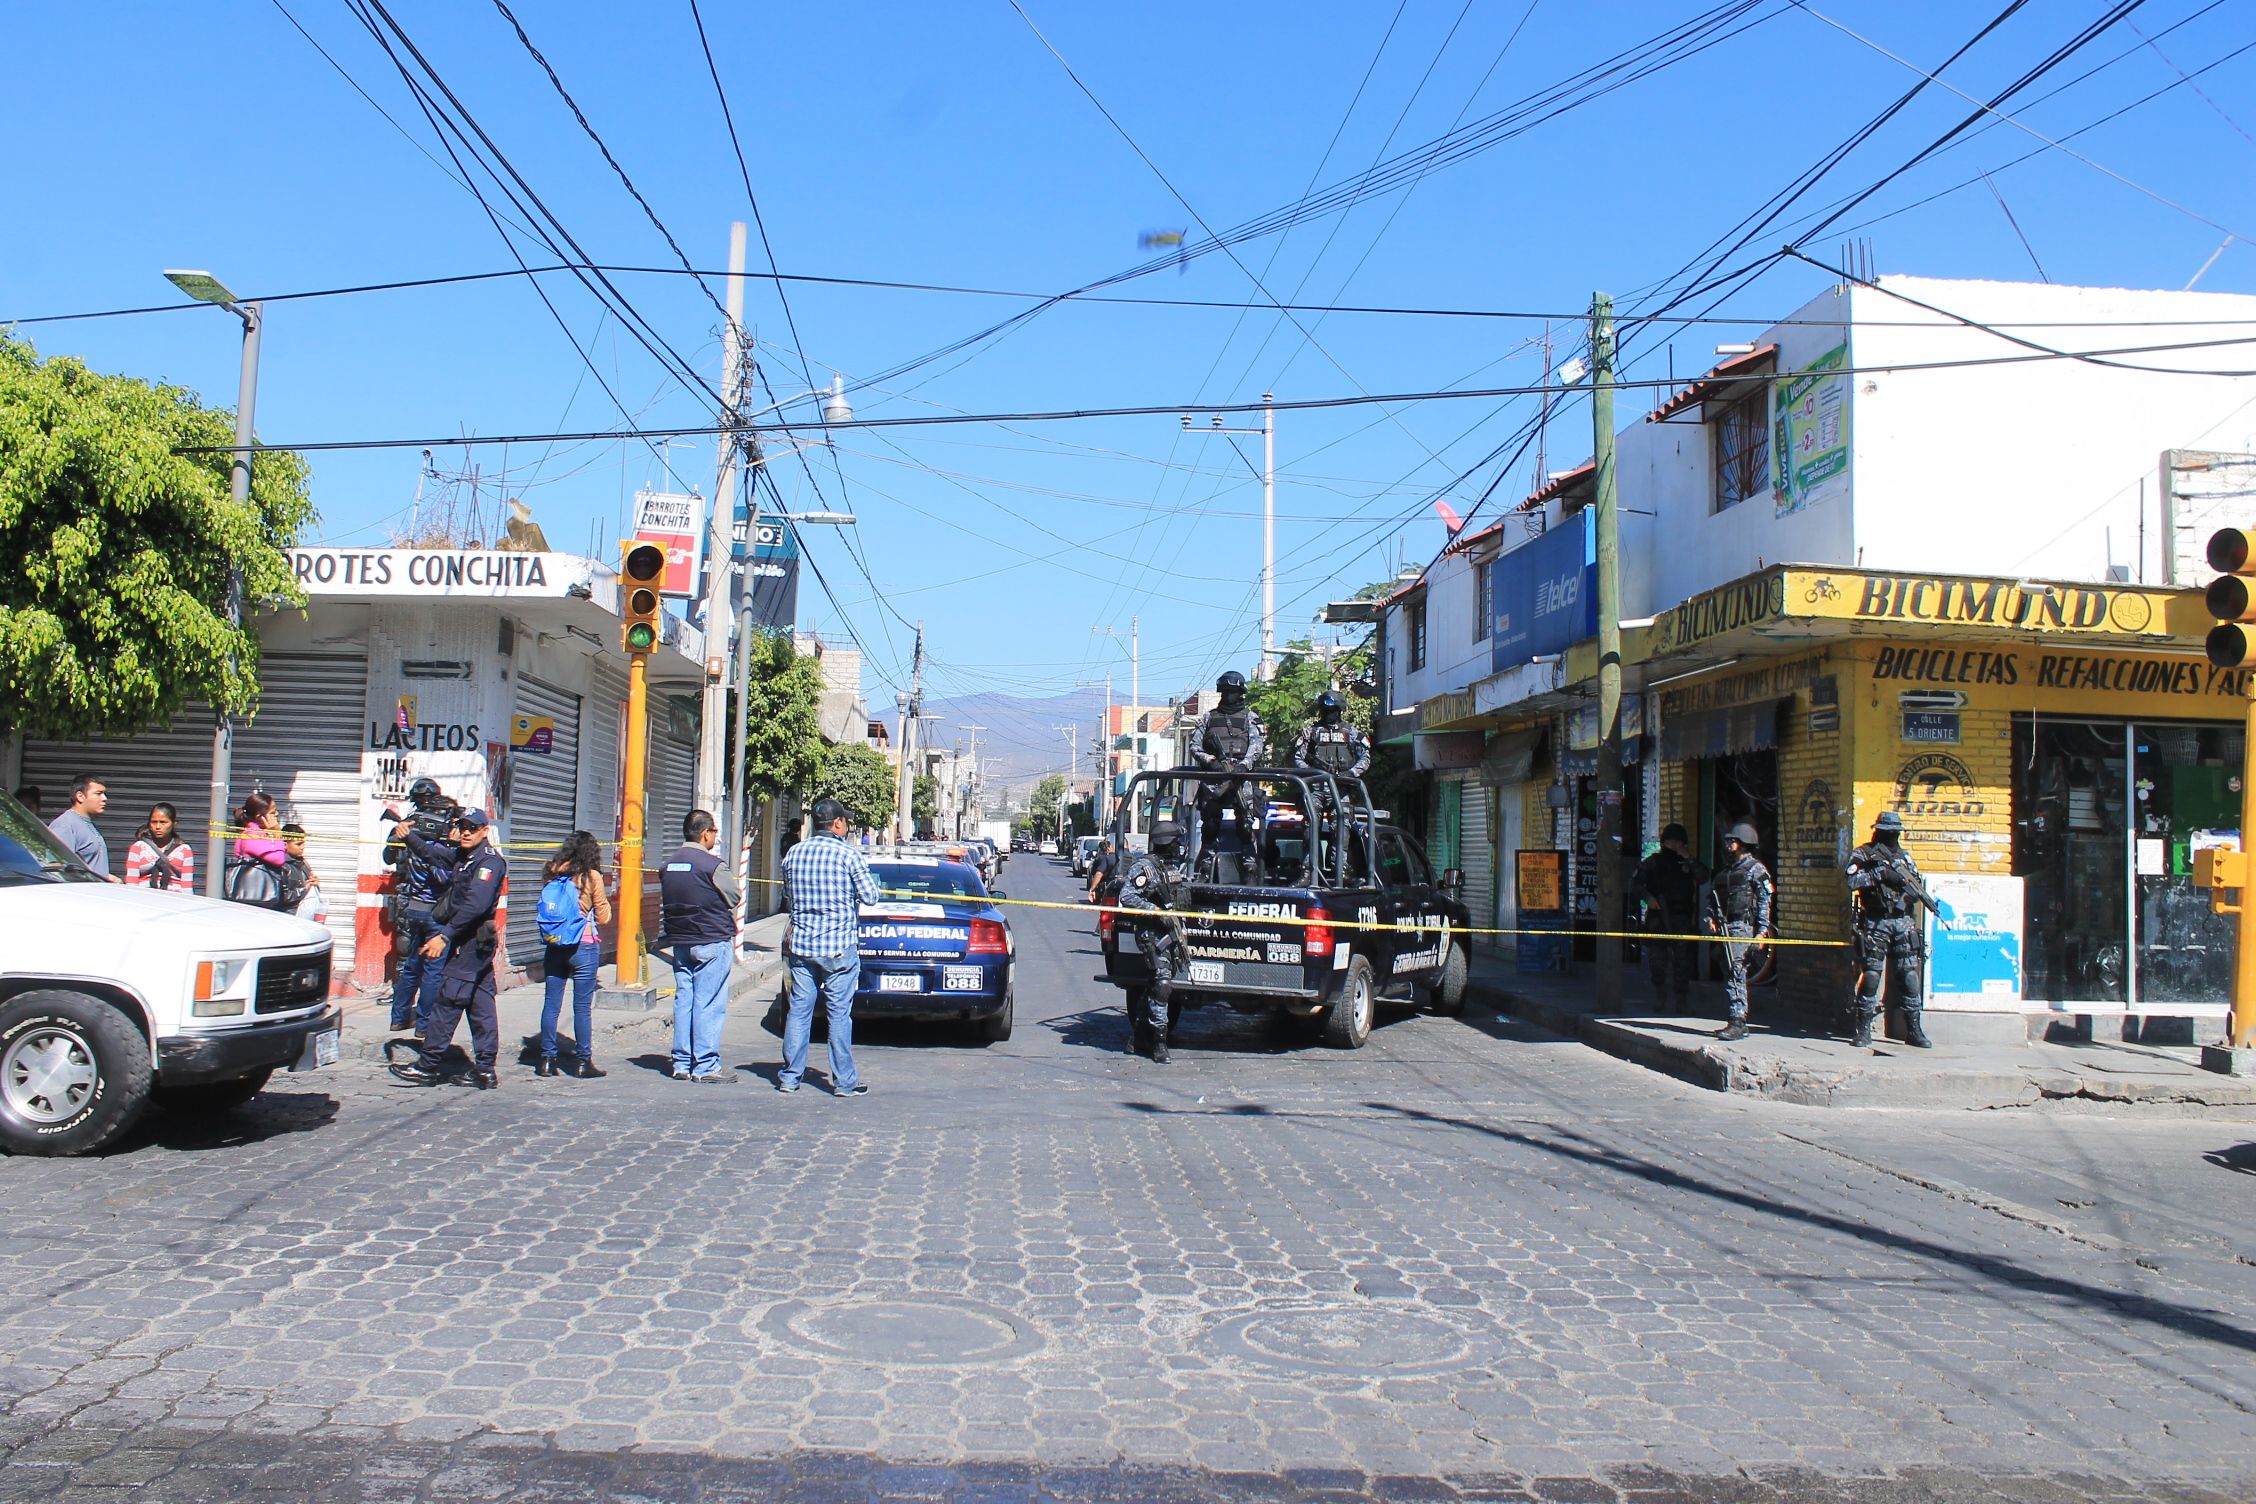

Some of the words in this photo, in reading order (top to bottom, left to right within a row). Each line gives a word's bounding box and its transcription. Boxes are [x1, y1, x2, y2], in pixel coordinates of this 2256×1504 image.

[641, 512, 690, 529] CONCHITA
[408, 555, 547, 587] CONCHITA
[1872, 646, 2018, 685] BICICLETAS
[2037, 655, 2202, 695] REFACCIONES
[1921, 715, 1942, 724] CALLE
[370, 721, 480, 751] LACTEOS
[1909, 728, 1914, 738] 5
[1918, 728, 1954, 739] ORIENTE
[1897, 757, 1928, 796] CENTRO
[1932, 756, 1943, 766] DE
[1945, 758, 1975, 796] SERVICIO
[1581, 874, 1598, 885] ZTE
[1228, 902, 1301, 920] FEDERAL
[858, 924, 897, 938] LICÍA
[906, 926, 969, 940] FEDERAL
[1220, 930, 1230, 938] LA
[1232, 931, 1282, 942] COMUNIDAD
[1190, 946, 1262, 961] DARMERÍA
[1268, 952, 1300, 963] 088
[1193, 968, 1220, 980] 17316
[886, 977, 916, 989] 12948
[946, 979, 980, 989] 088
[95, 1077, 105, 1100] All
[37, 1107, 94, 1134] Terrain
